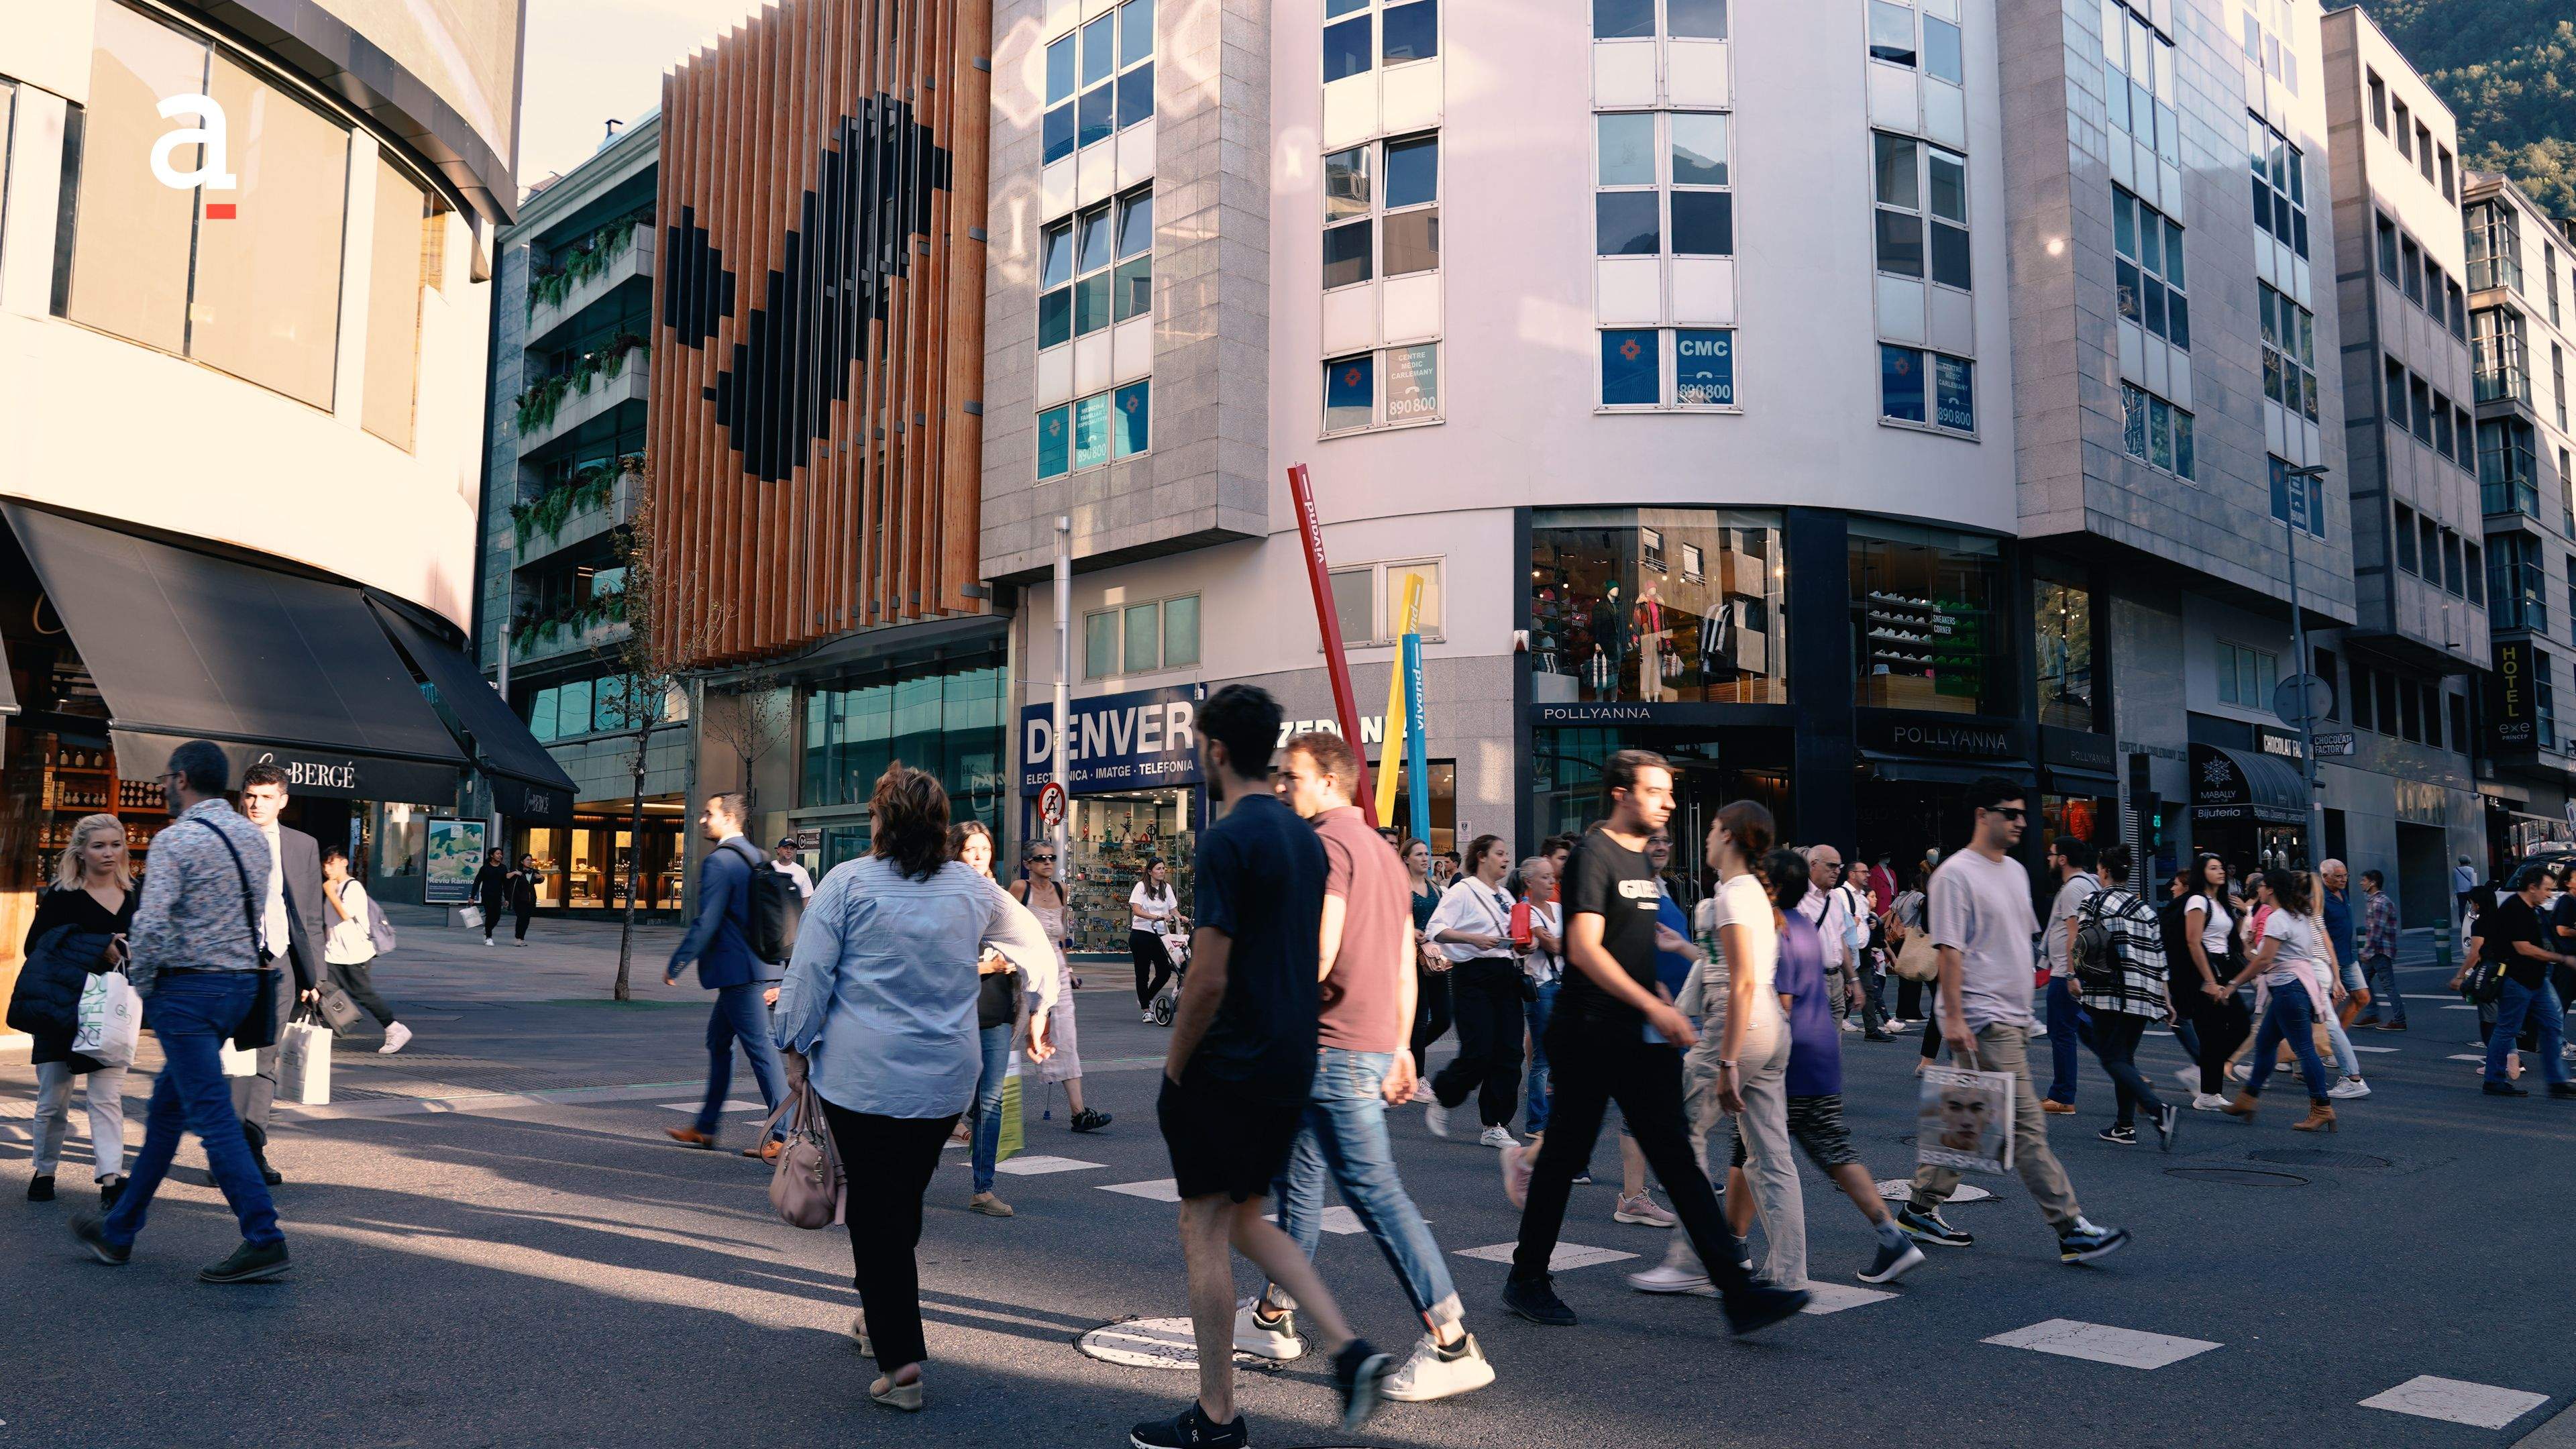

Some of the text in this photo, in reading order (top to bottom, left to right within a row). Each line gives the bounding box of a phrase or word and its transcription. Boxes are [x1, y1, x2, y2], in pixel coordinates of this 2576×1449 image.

[1680, 340, 1728, 356] CMC
[1398, 352, 1426, 362] CENTRE
[1391, 368, 1434, 380] CARLEMANY
[1943, 364, 1963, 374] CENTRE
[1938, 379, 1968, 391] CARLEMANY
[1304, 501, 1325, 564] vivand
[1933, 604, 1942, 614] THE
[1933, 614, 1955, 625] SNEAKERS
[1933, 625, 1952, 635] CORNER
[2502, 646, 2520, 717] HOTEL
[1413, 668, 1424, 731] vivand
[1544, 708, 1651, 720] POLLYANNA
[1894, 726, 2008, 750] POLLYANNA
[2314, 734, 2351, 745] CHOCOLAT
[2263, 734, 2292, 757] CHOCOLAT
[2314, 744, 2345, 755] FACTORY
[2071, 750, 2110, 765] POLLYANNA
[1026, 759, 1194, 785] ELECTNICA IMATGE TELEFONIA
[2200, 790, 2237, 799] MABALLY
[2198, 808, 2241, 819] Bijuteria
